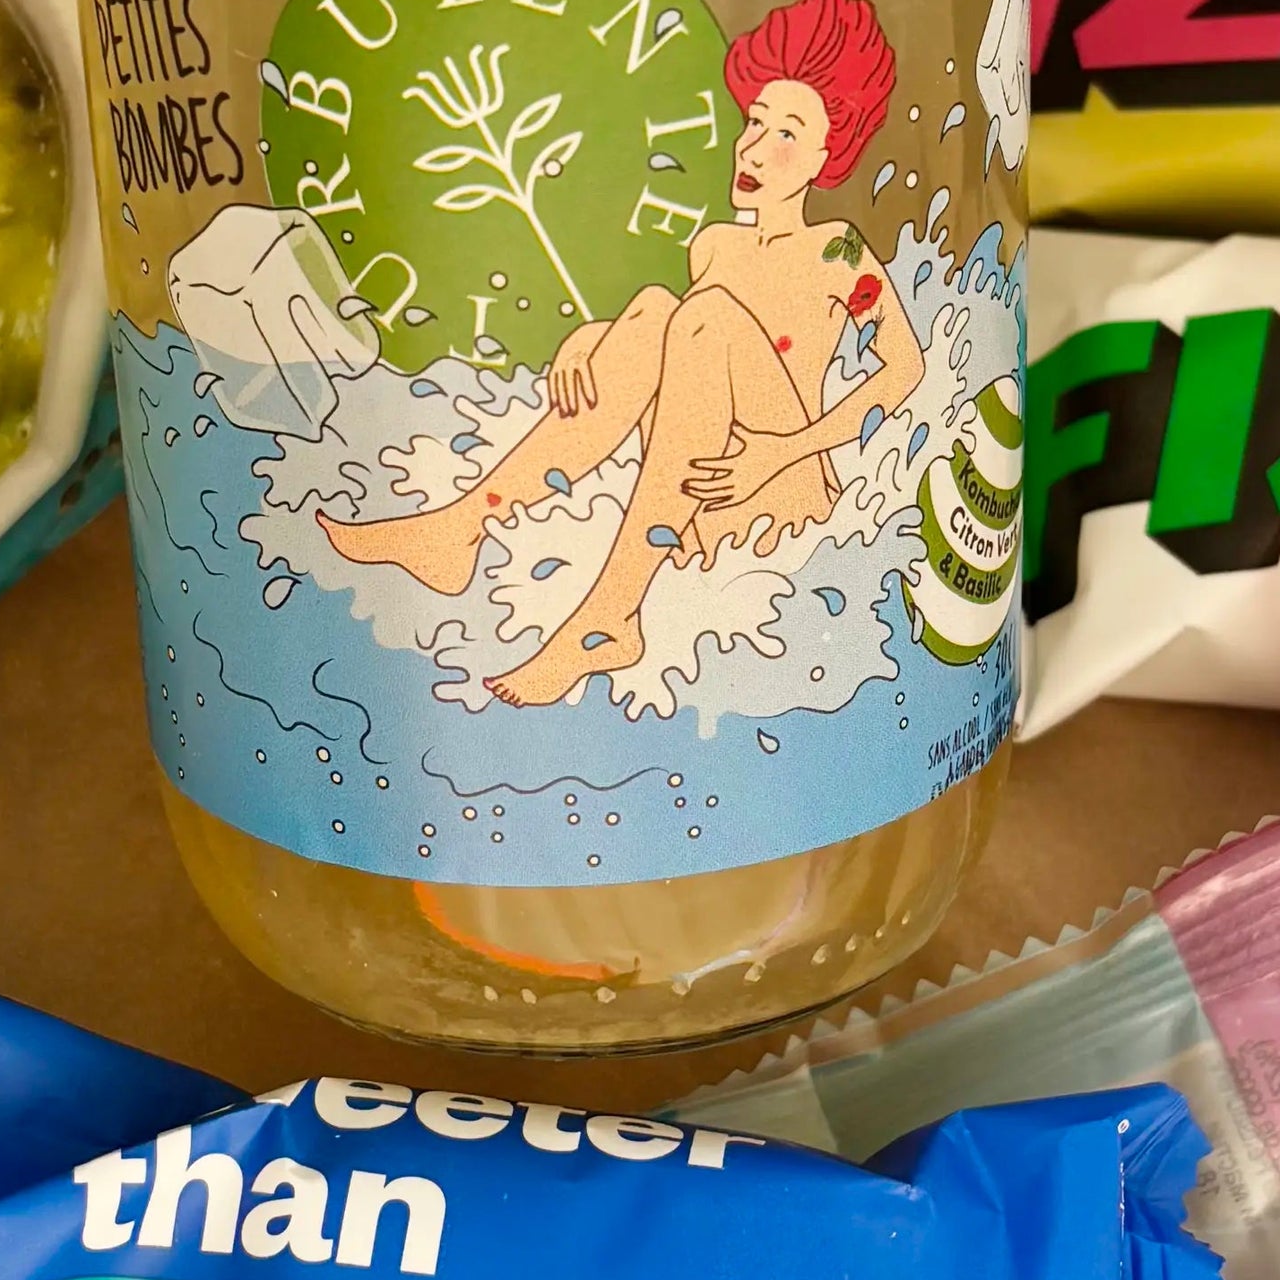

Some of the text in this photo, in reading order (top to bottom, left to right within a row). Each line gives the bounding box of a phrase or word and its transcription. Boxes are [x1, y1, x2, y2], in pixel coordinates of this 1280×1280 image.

[110, 91, 246, 195] BOMBES
[950, 505, 995, 559] Citron
[938, 551, 1002, 600] & Basilic
[74, 1125, 448, 1278] than
